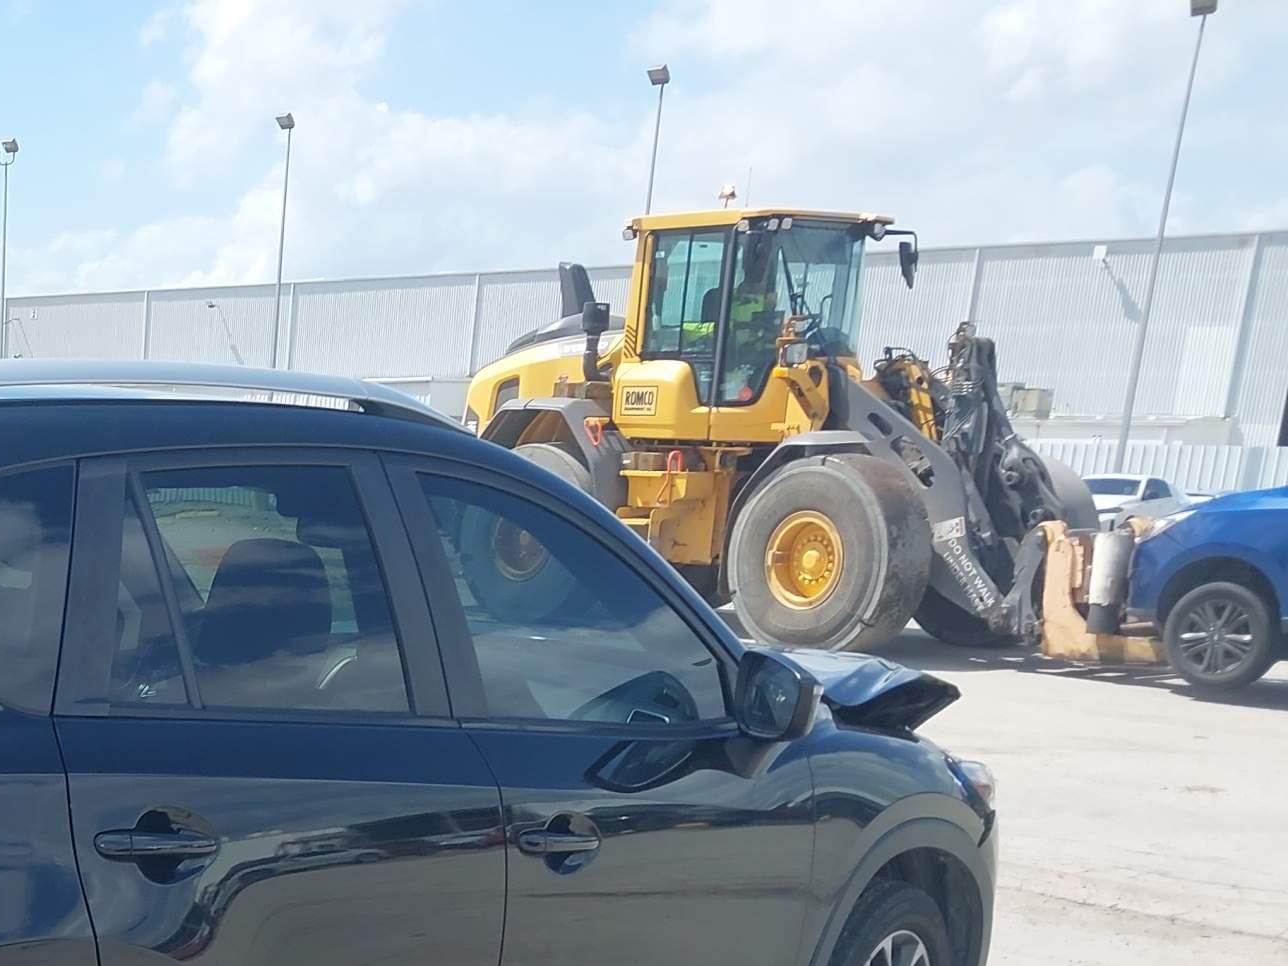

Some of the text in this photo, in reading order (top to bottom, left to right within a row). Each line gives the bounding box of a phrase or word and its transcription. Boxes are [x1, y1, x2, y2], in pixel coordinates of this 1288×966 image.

[625, 391, 654, 405] ROMCO
[947, 538, 996, 607] DO NOT WALK
